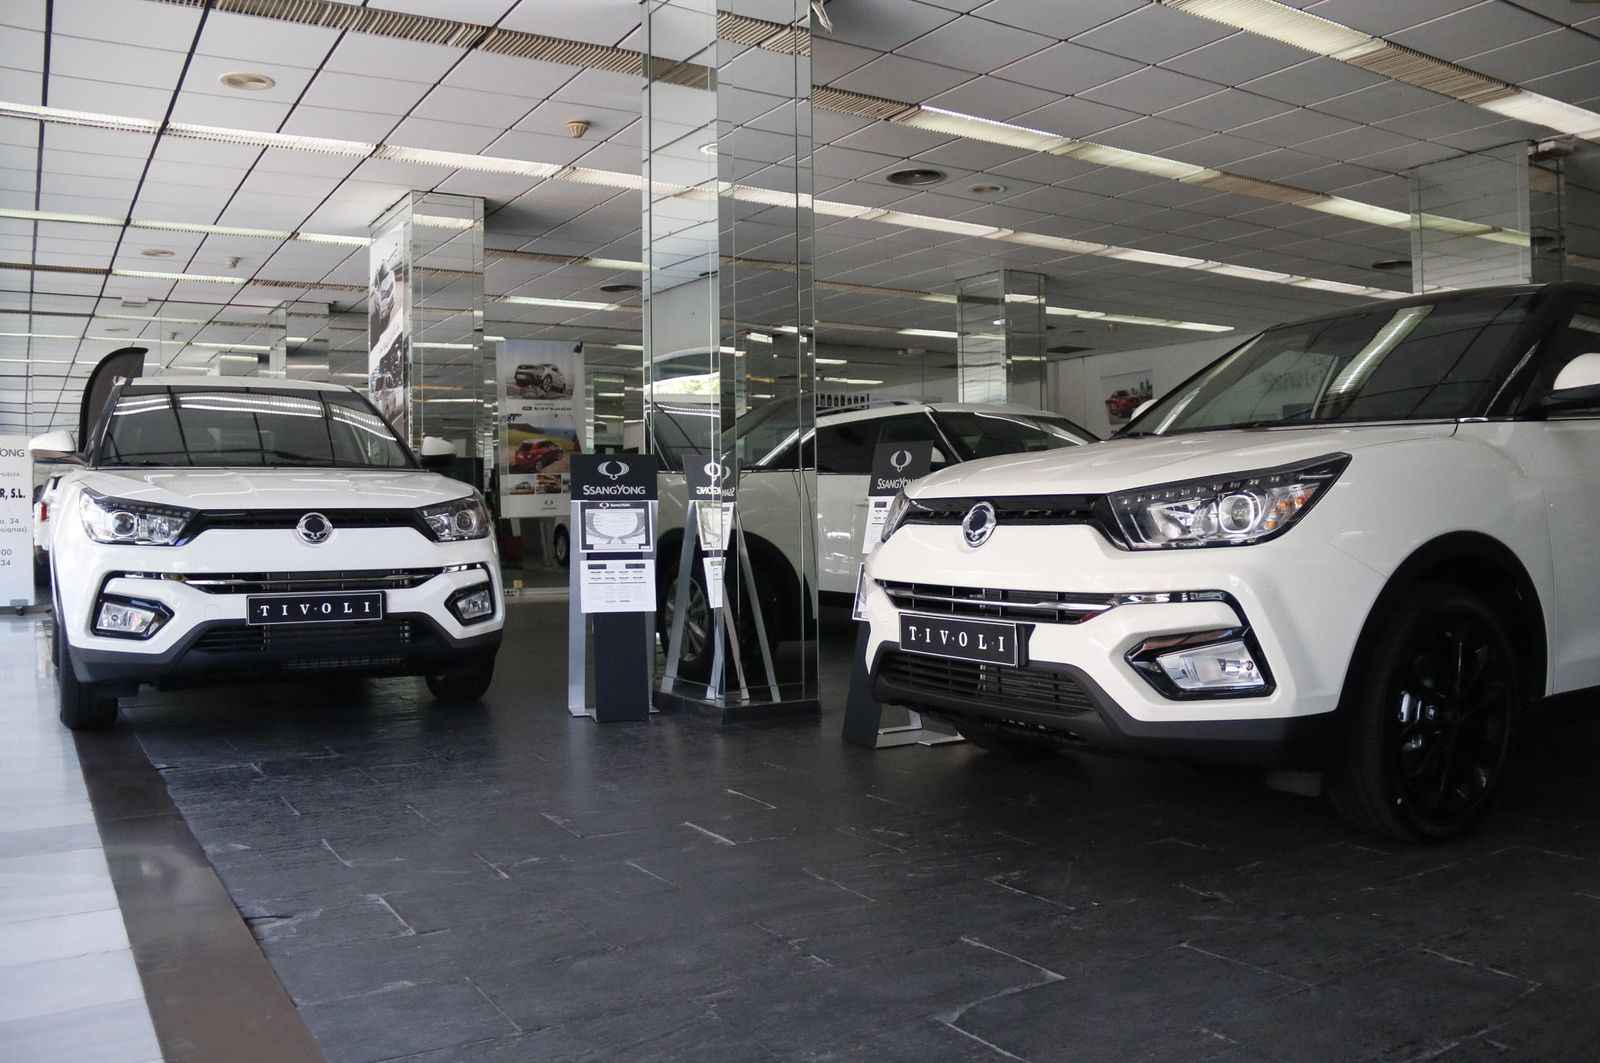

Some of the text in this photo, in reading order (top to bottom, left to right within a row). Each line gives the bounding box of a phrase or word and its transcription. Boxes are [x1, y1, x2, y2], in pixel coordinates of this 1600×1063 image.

[0, 447, 25, 458] ONG
[11, 488, 26, 499] S.L.
[583, 484, 646, 496] SSANGYONG
